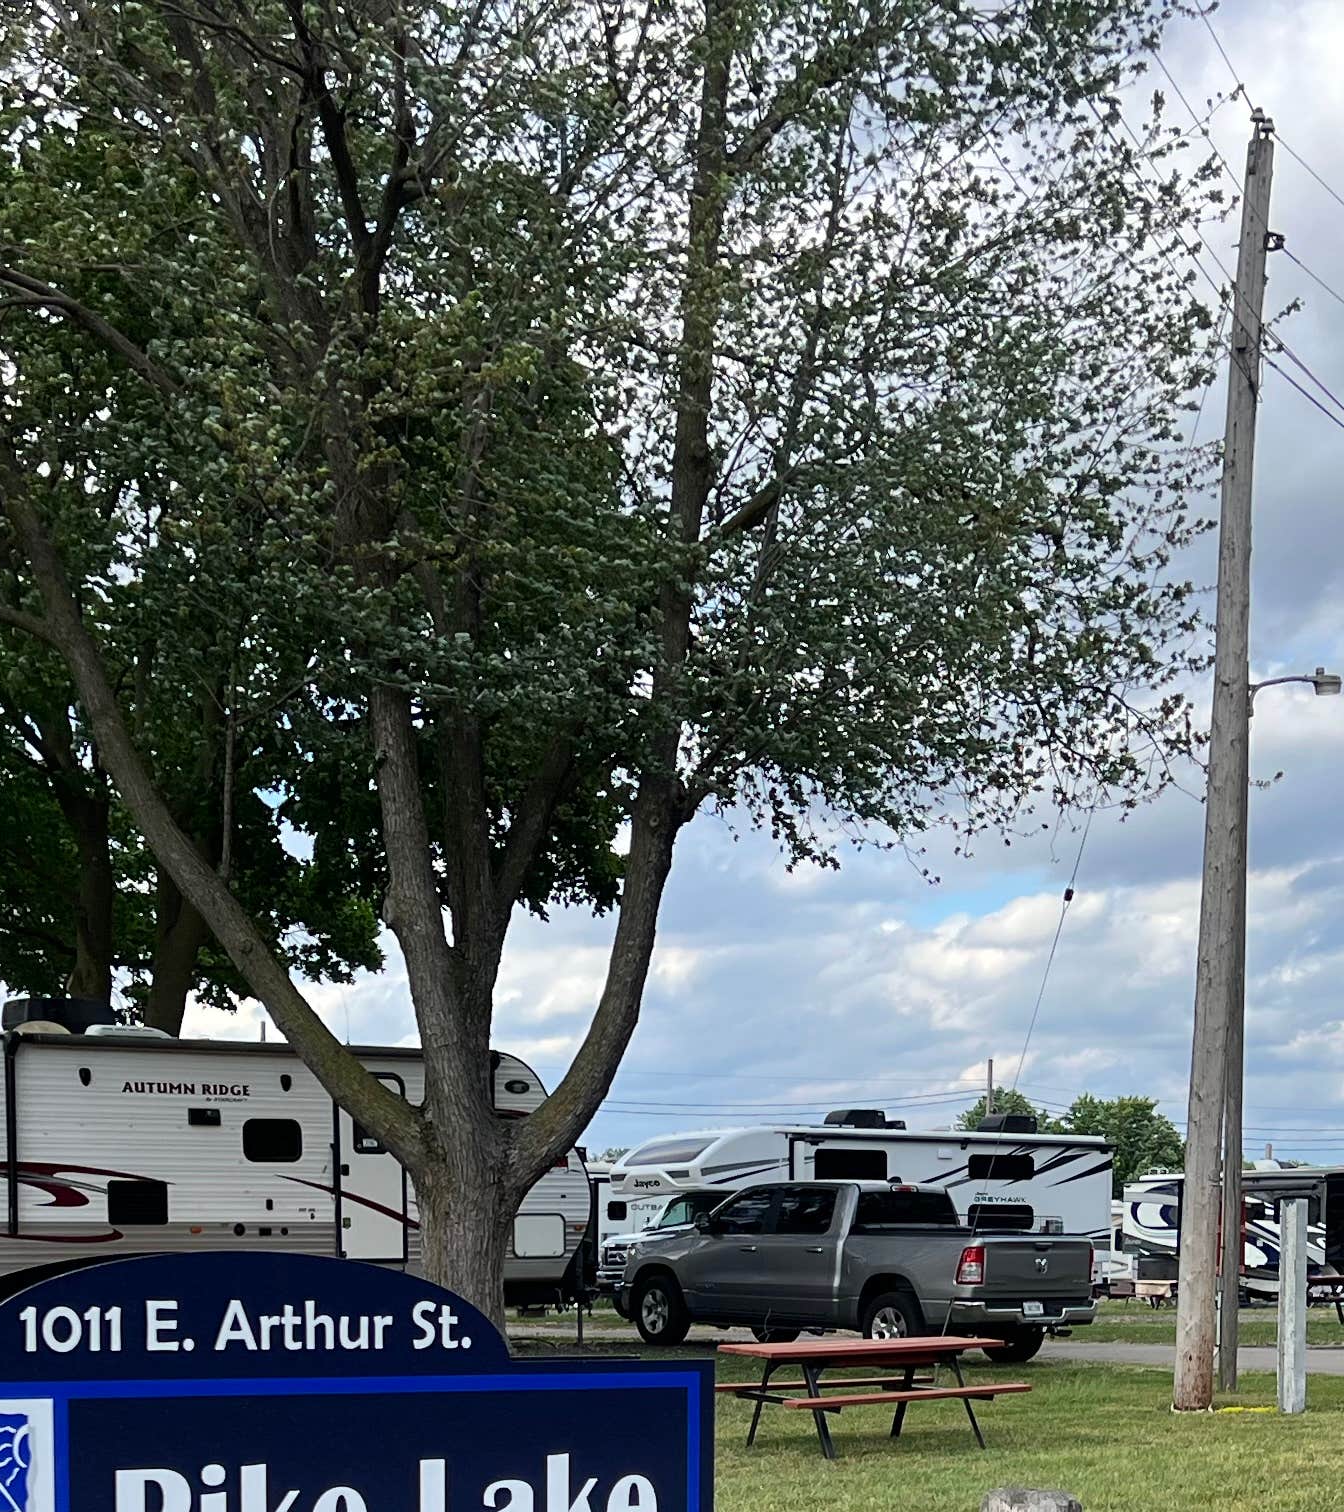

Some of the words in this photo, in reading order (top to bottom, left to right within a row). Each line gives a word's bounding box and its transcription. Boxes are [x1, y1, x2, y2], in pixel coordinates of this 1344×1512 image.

[122, 1082, 195, 1095] AUTUMN
[202, 1084, 250, 1096] RIDGE
[634, 1179, 661, 1188] Jayco
[19, 1305, 122, 1353] 1011
[146, 1300, 195, 1351] E.
[215, 1300, 393, 1351] Arthur
[412, 1301, 472, 1350] St.
